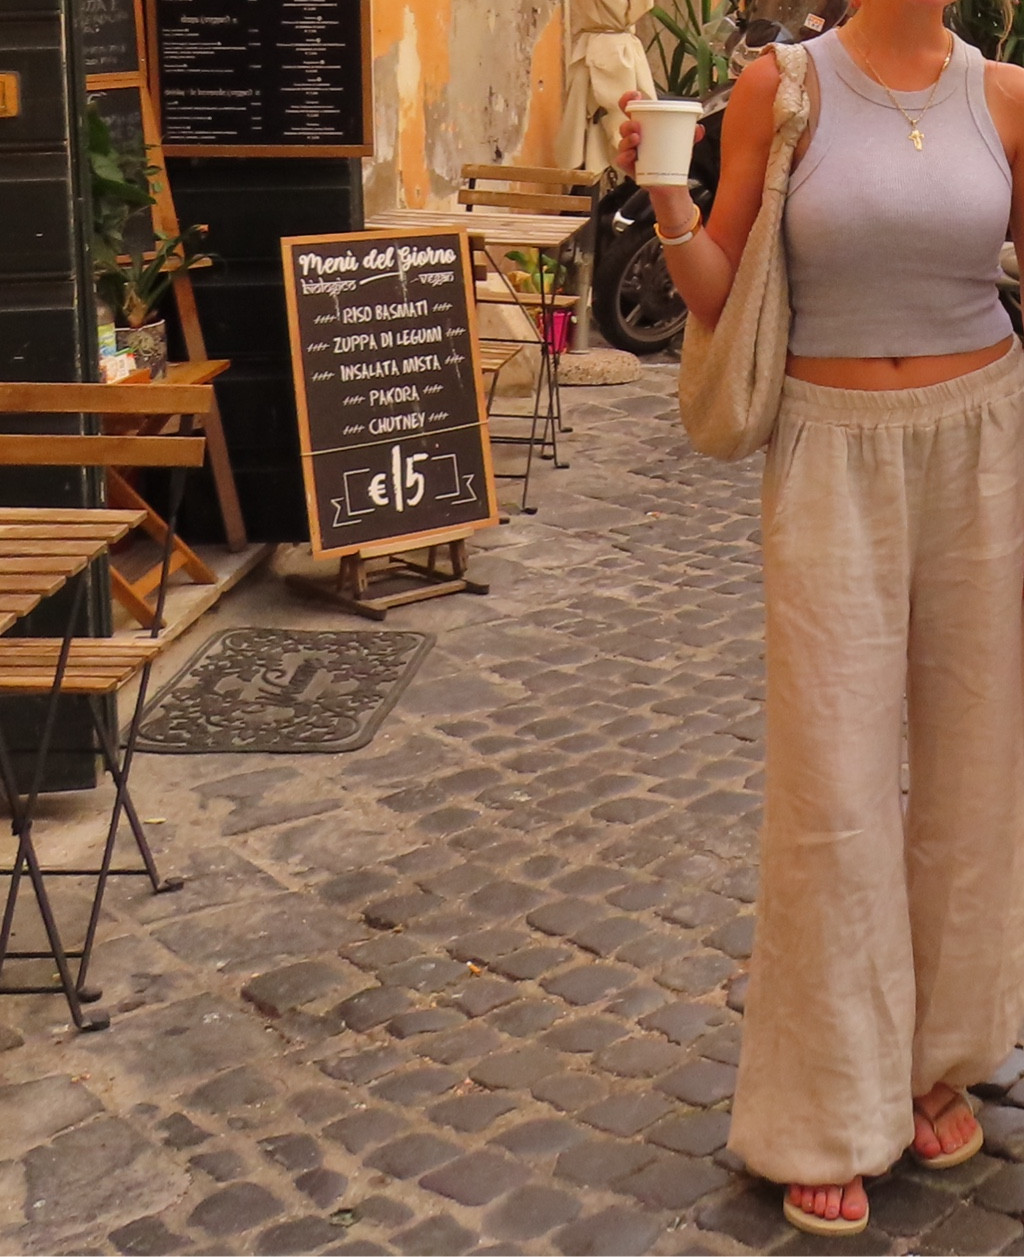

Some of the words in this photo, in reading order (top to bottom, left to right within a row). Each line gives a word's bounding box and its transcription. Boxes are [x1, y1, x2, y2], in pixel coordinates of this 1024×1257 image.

[299, 251, 359, 276] Menù
[362, 246, 395, 270] del
[399, 246, 457, 271] Giorno
[342, 305, 373, 324] RISO
[375, 299, 428, 321] BASMATI
[333, 334, 378, 354] ZUPPA
[380, 331, 394, 348] DI
[396, 325, 443, 346] LEGUMI
[340, 361, 400, 382] INSALATA
[402, 354, 442, 374] MISTA
[369, 385, 420, 407] PAKORA
[368, 412, 426, 434] CHUTNEY
[367, 444, 429, 512] €15
